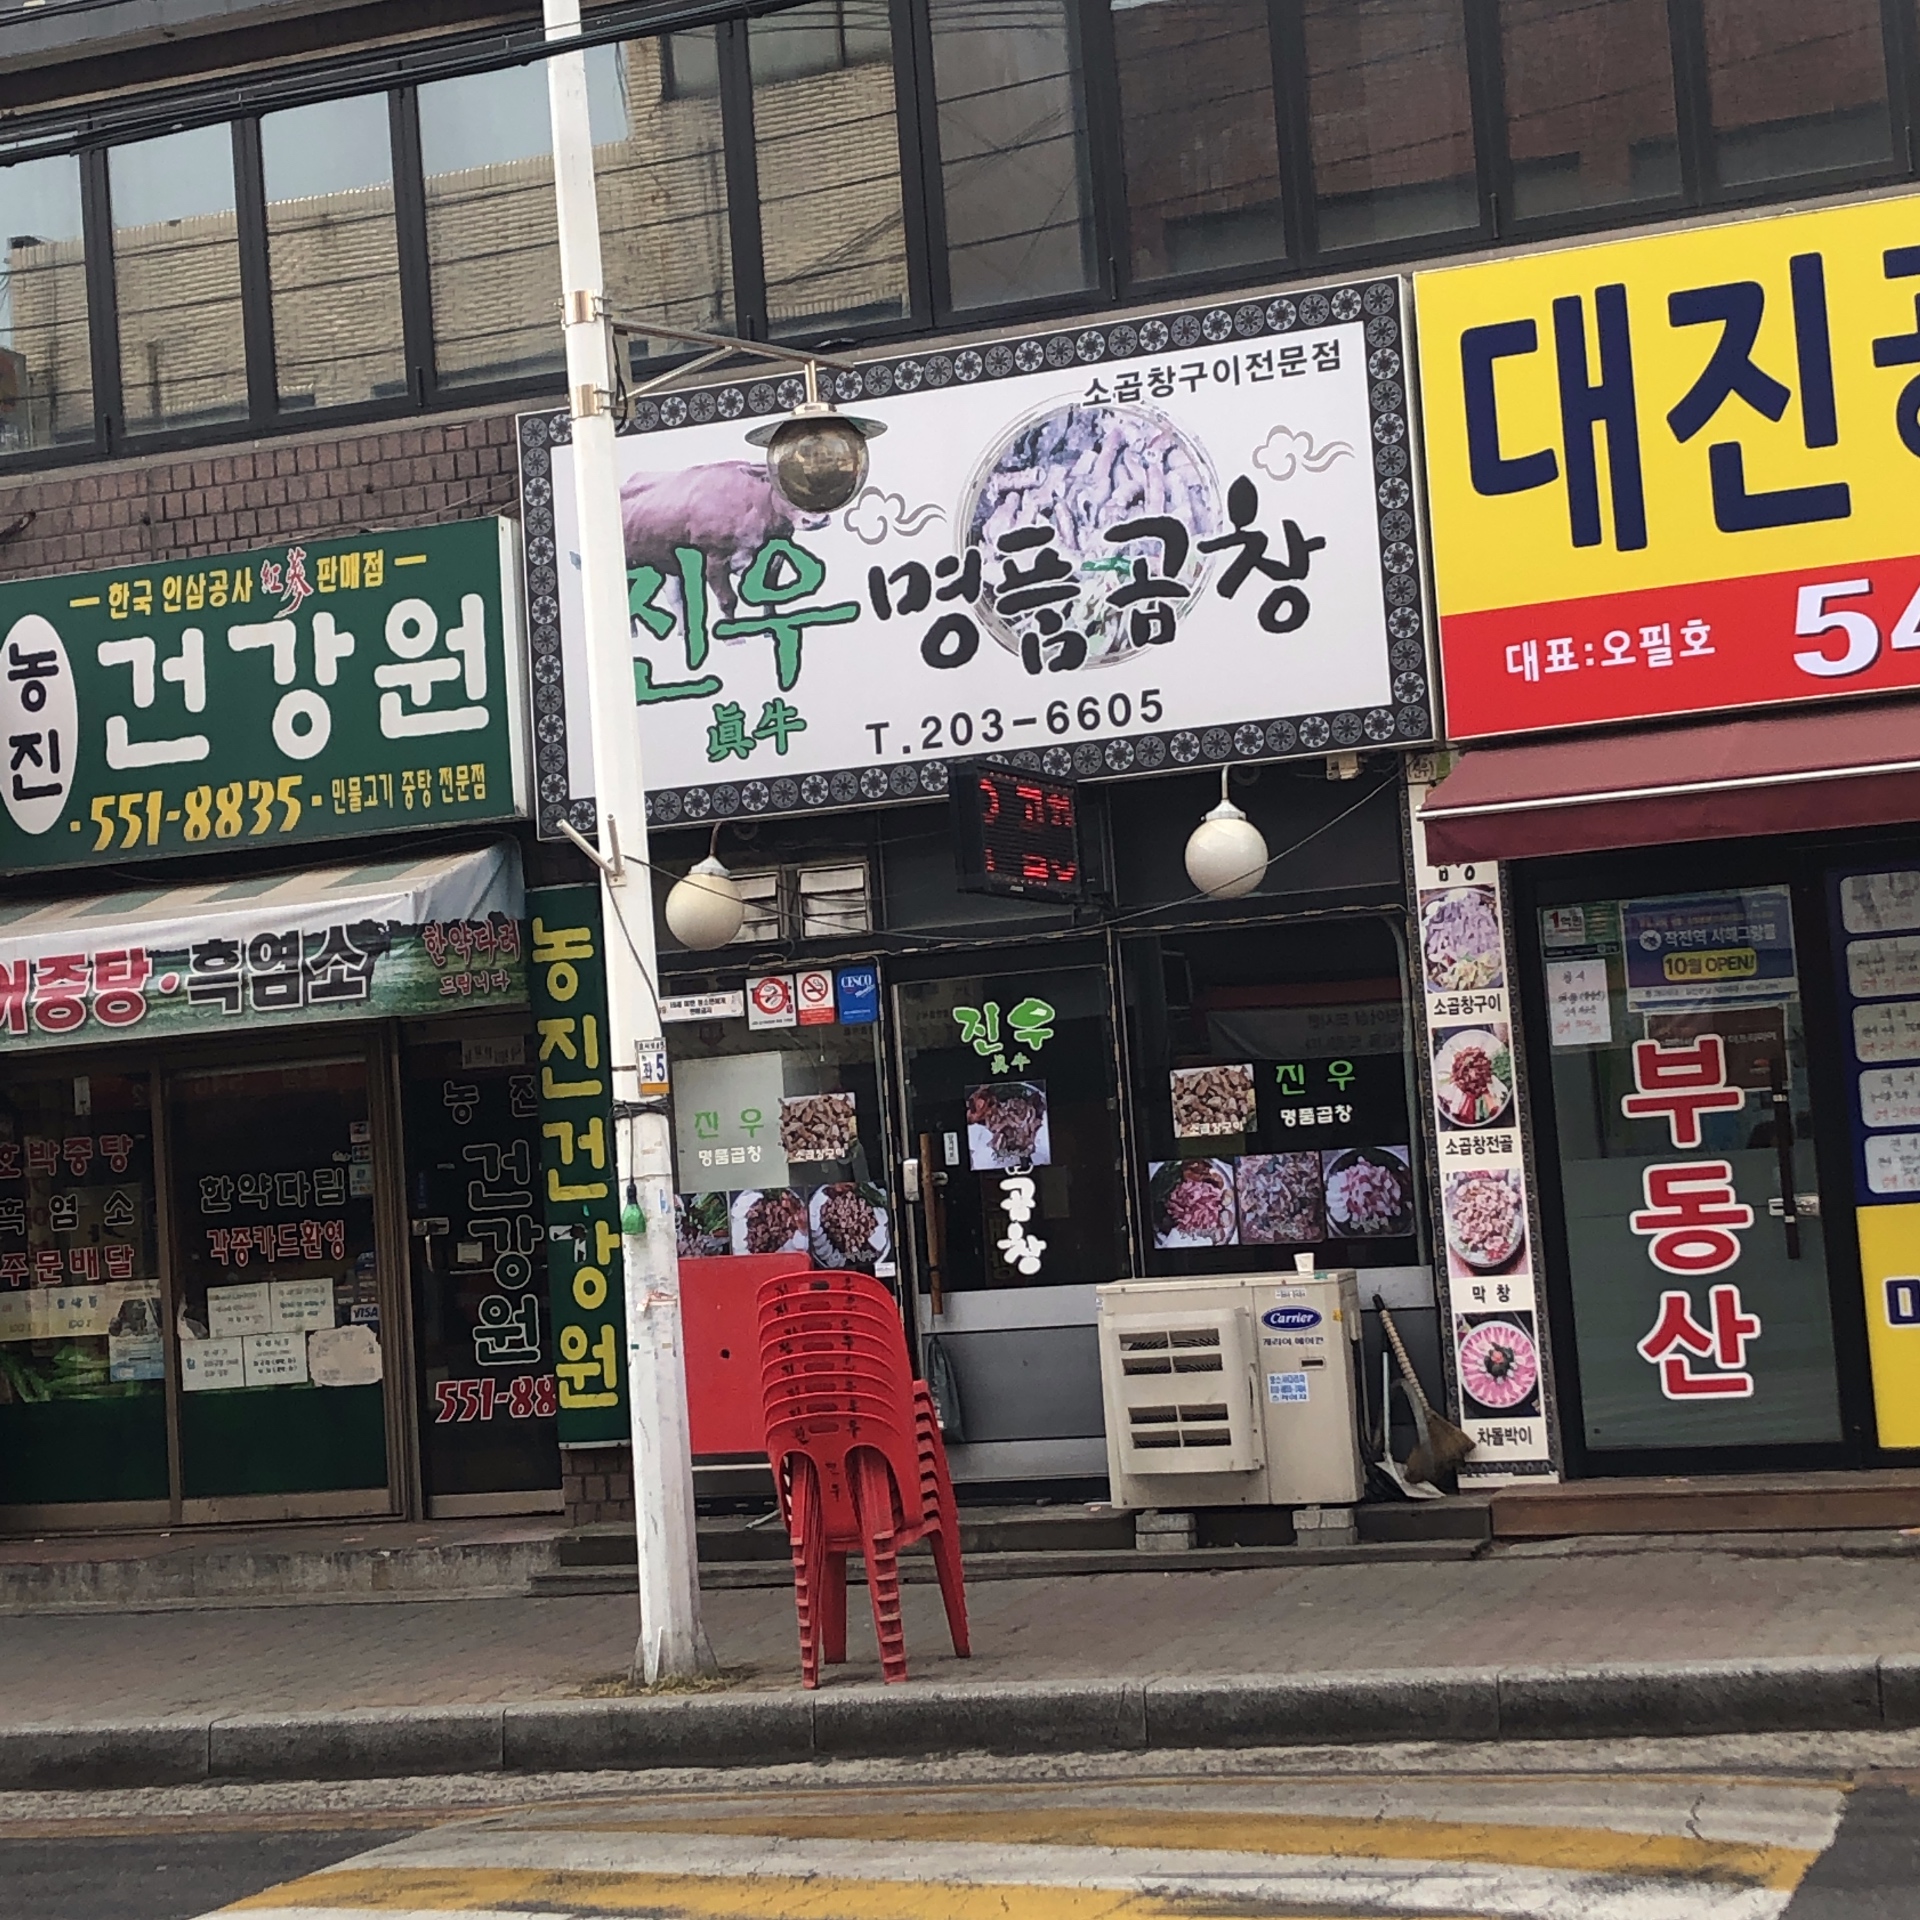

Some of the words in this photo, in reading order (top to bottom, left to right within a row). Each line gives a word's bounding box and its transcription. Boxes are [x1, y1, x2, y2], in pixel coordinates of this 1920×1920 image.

[1081, 341, 1343, 407] 소곱창구이전문점
[1460, 244, 1920, 552] 대진
[107, 580, 154, 620] 한국
[161, 572, 254, 613] 인삼공사
[316, 549, 386, 594] 판매점
[627, 537, 860, 706] 진우
[1505, 619, 1717, 683] 대표:오필호
[98, 592, 490, 770] 건강원
[8, 641, 64, 802] 농진
[865, 689, 1164, 757] T.203-6605
[330, 779, 395, 815] 민물고기
[401, 773, 434, 811] 중탕
[438, 762, 487, 803] 전문점
[90, 775, 304, 852] 551-8835
[422, 918, 521, 966] 한약다려
[1706, 954, 1755, 972] OPEN!
[187, 926, 369, 1014] 흑염소
[439, 968, 511, 995] 드립니다
[841, 974, 873, 988] CESCO
[953, 998, 1056, 1056] 진우
[1433, 993, 1501, 1017] 소곱창구이
[656, 1052, 665, 1082] 5
[1280, 1104, 1353, 1127] 명품곱창
[0, 1133, 134, 1178] 호박중탕
[698, 1145, 761, 1167] 명품곱창
[1445, 1134, 1514, 1157] 소곱창전골
[199, 1167, 346, 1213] 한약다림
[997, 1163, 1047, 1275] 곱창
[1621, 1033, 1761, 1399] 부동산
[0, 1244, 135, 1287] 주문배달
[206, 1219, 345, 1267] 각종카드환영
[354, 1304, 378, 1319] VISA
[1270, 1311, 1314, 1325] Carrier
[1477, 1425, 1533, 1447] 차돌박이
